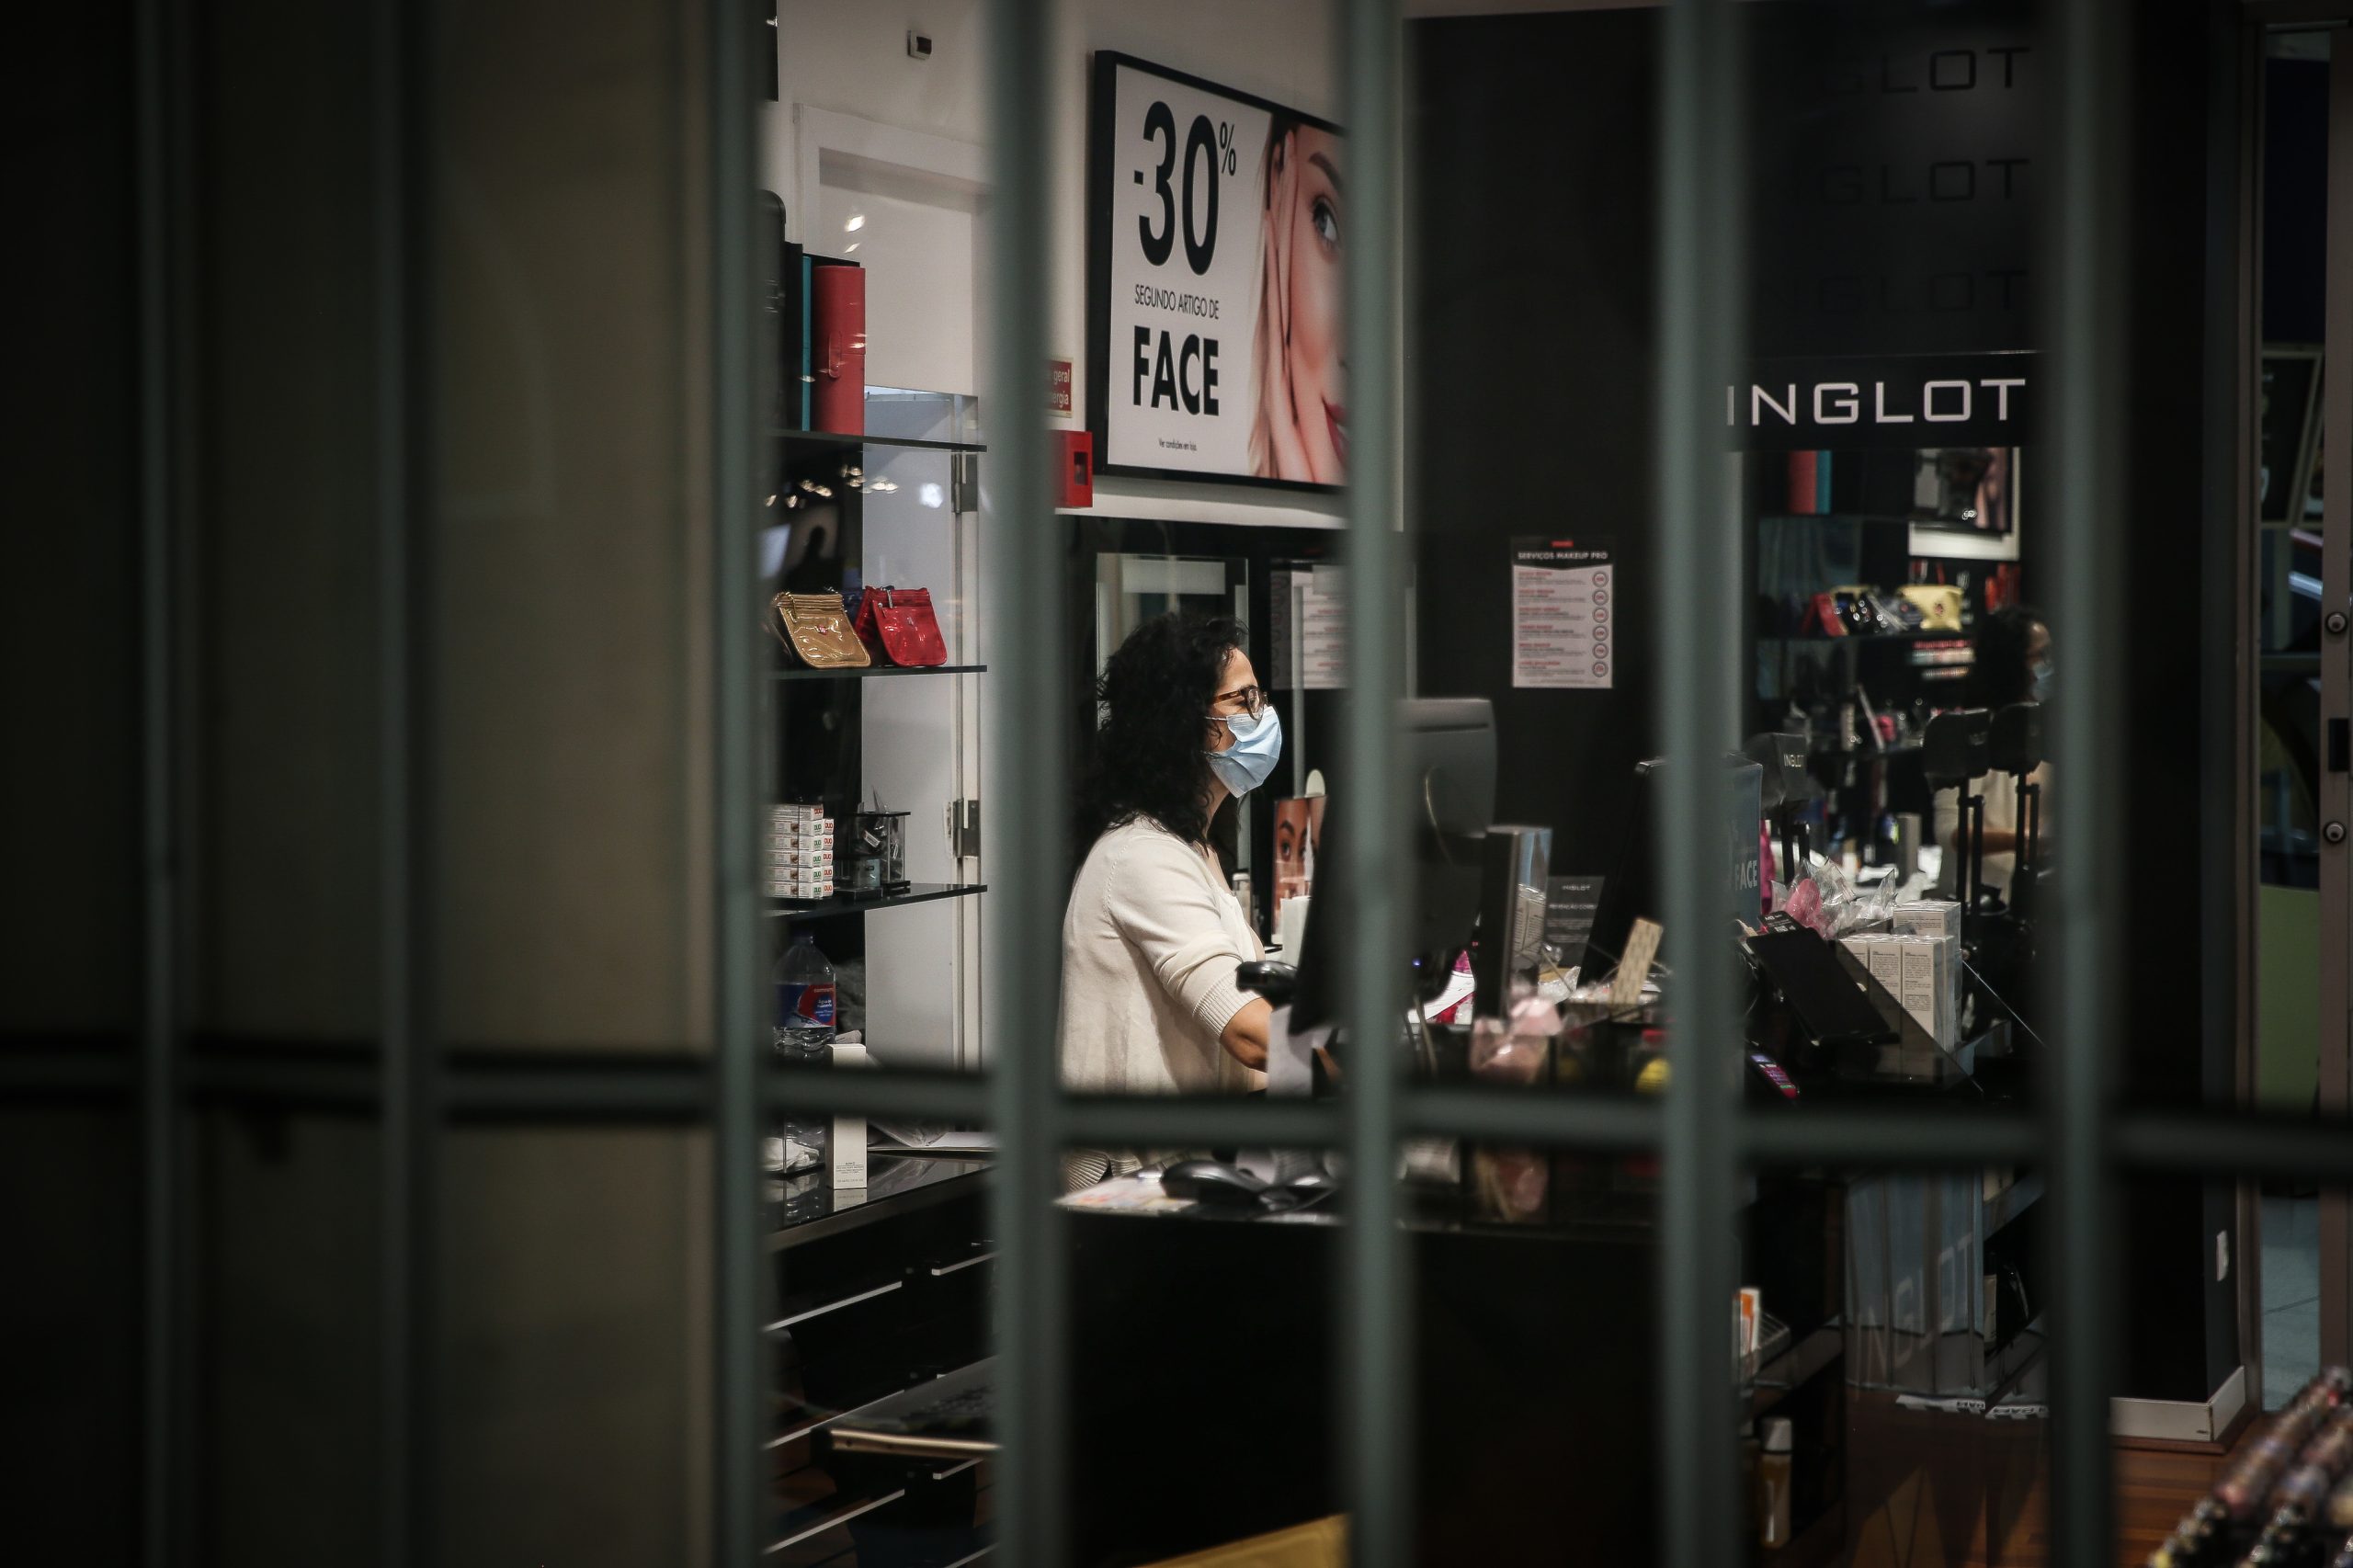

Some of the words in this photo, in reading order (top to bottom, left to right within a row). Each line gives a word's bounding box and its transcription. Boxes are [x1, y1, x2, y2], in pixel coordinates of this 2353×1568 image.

[1821, 46, 2030, 96] GLOT
[1818, 158, 2030, 206] GLOT
[1134, 284, 1176, 312] SEGUNDO
[1177, 294, 1208, 318] ARTIGO
[1209, 300, 1219, 320] DE
[1133, 324, 1220, 416] FACE
[1727, 379, 2026, 426] INGLOT
[1518, 551, 1555, 561] SERVIÇOS
[1556, 551, 1589, 560] MAKEUP
[1591, 551, 1608, 560] PRO
